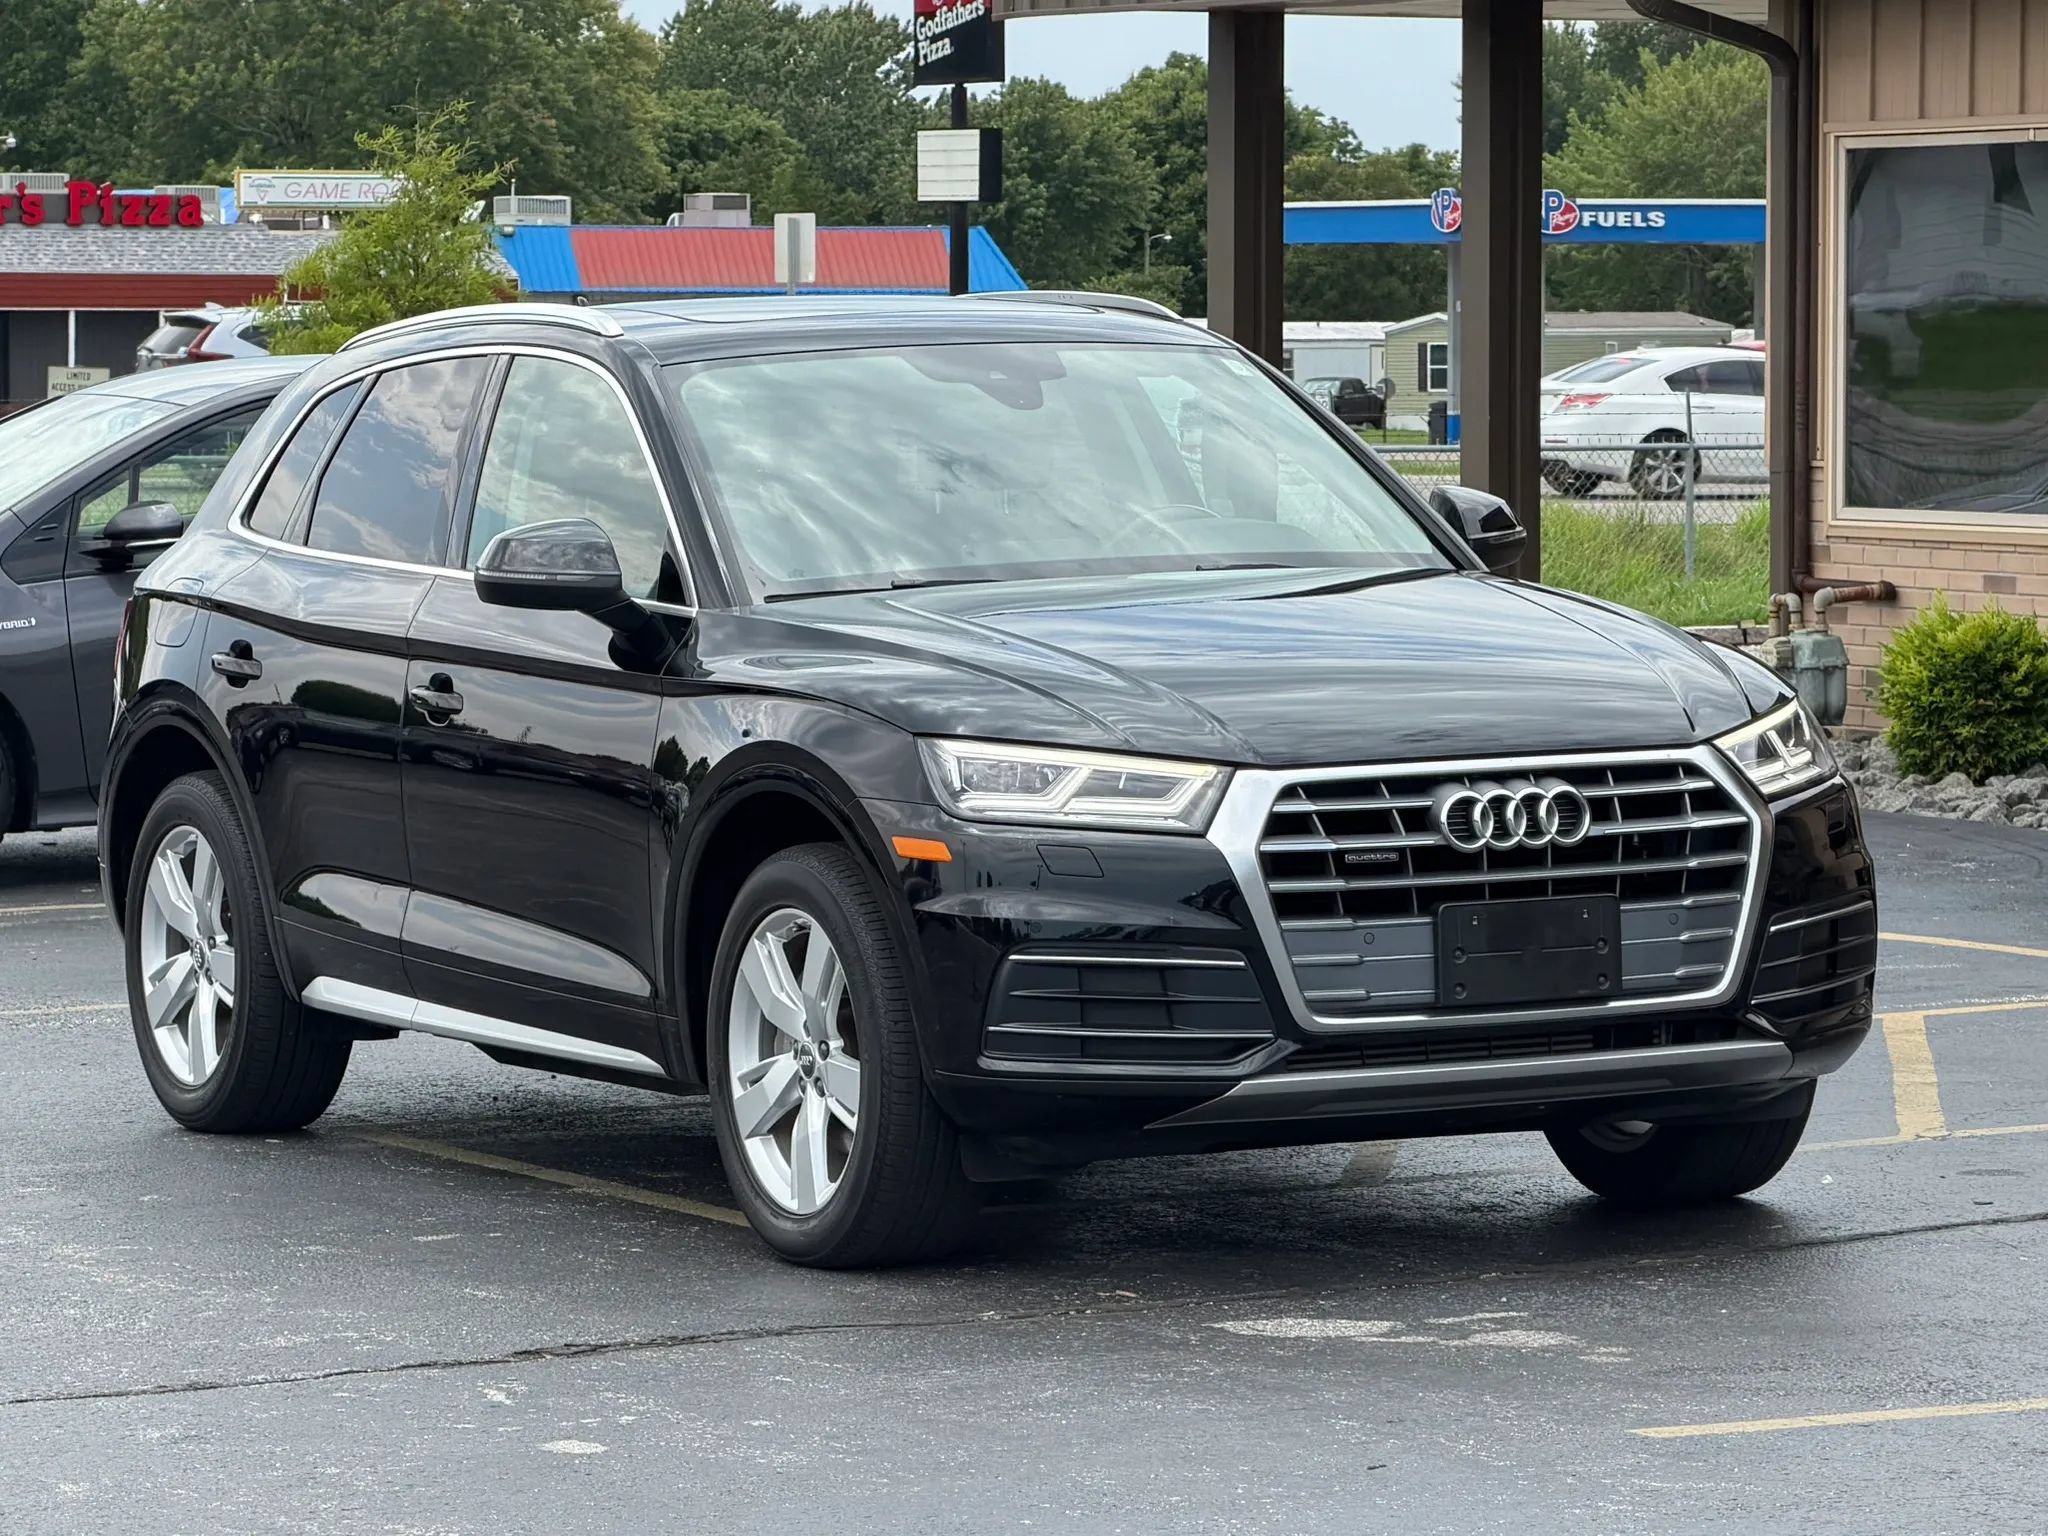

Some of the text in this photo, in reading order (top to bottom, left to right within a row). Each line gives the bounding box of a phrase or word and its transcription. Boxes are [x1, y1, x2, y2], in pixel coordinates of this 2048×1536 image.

[918, 38, 951, 67] Pizza
[284, 182, 352, 199] GAME
[65, 180, 205, 227] Pizza
[1581, 211, 1666, 227] FUELS
[66, 371, 91, 381] LIMITED
[1348, 854, 1397, 862] quattro
